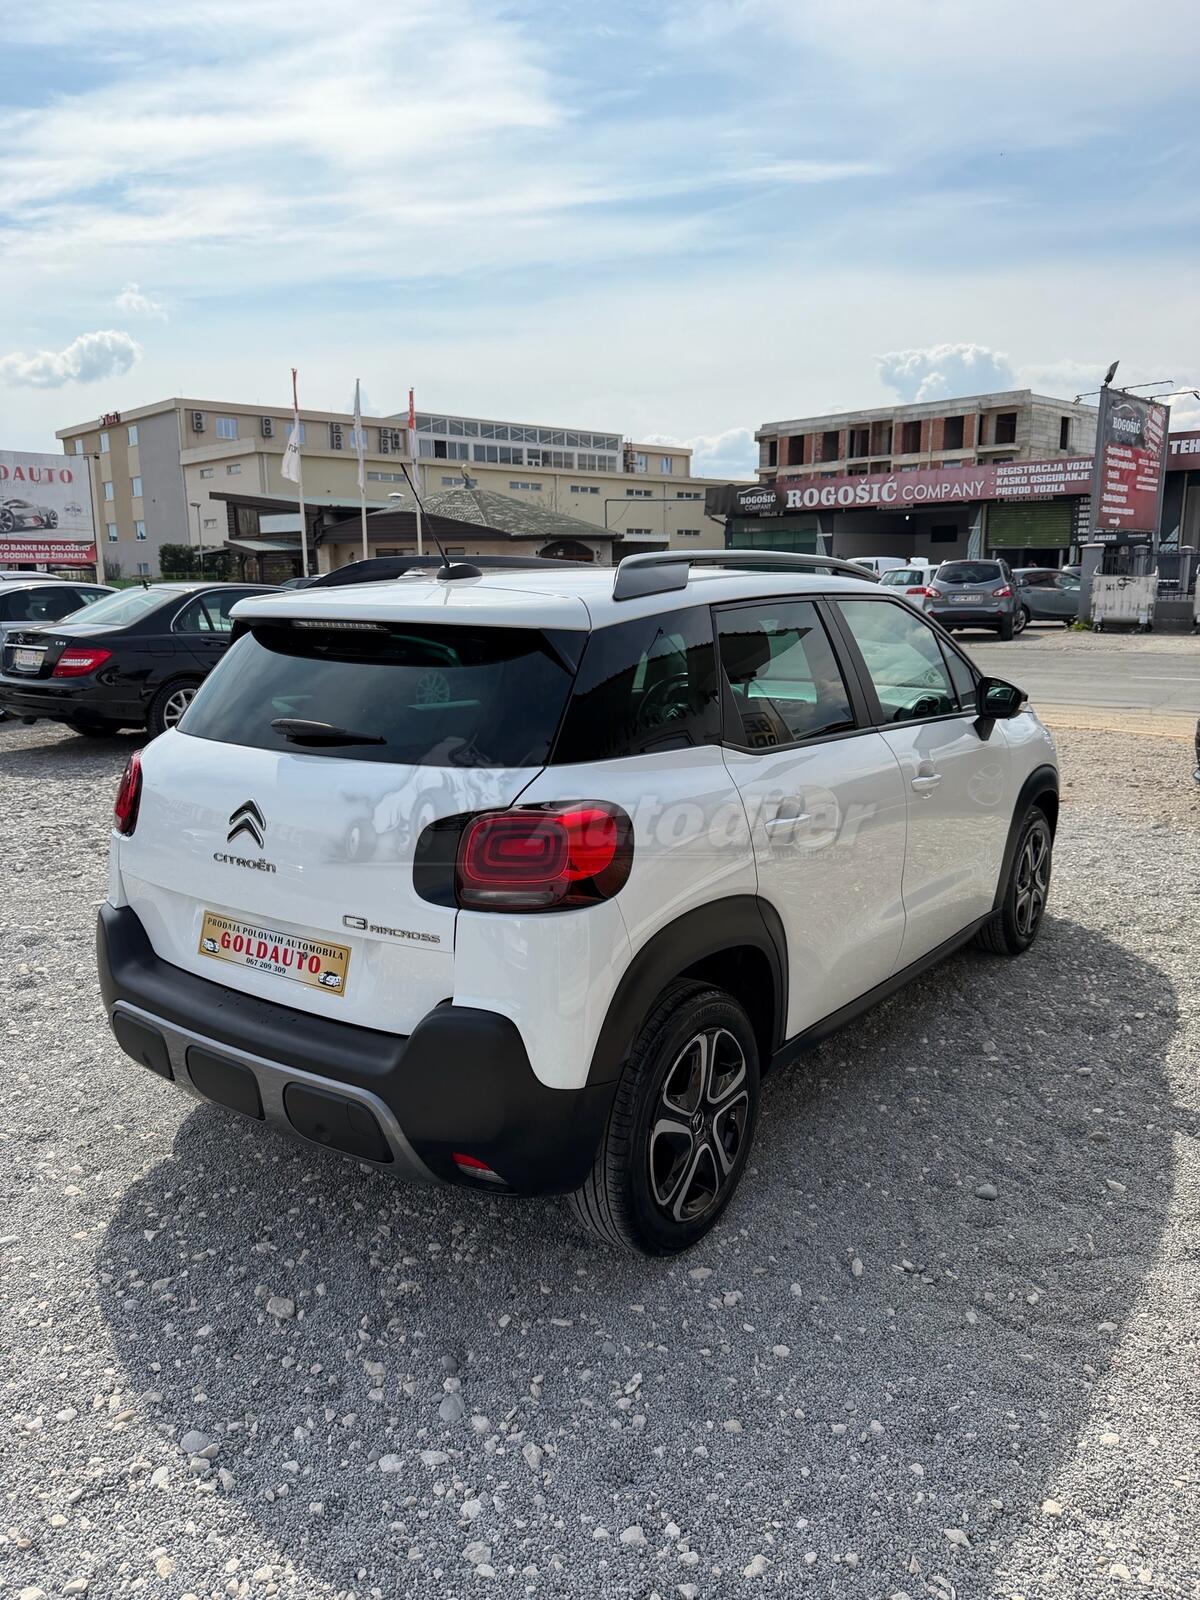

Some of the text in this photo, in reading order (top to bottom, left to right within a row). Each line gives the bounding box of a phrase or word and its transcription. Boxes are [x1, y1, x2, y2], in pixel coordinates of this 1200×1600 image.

[1169, 439, 1200, 455] TEH
[0, 465, 73, 483] DAUTO
[997, 463, 1063, 475] REGISTRACIJA
[1066, 461, 1094, 470] VOZIL
[996, 472, 1090, 485] KASKO OSIGURANJE
[786, 476, 984, 508] ROGOŠIĆ COMPANY
[995, 484, 1065, 495] PREVOD VOZILA
[740, 492, 776, 505] ROGOŠIĆ
[51, 551, 87, 559] ŽIRANATA
[213, 852, 277, 873] CITROËN
[343, 914, 441, 943] C3 AIRCROSS
[207, 917, 344, 960] PRODAJA POLOVNIH AUTOMOBILA
[220, 931, 321, 974] GOLDAUTO
[245, 957, 287, 974] 067 209 309
